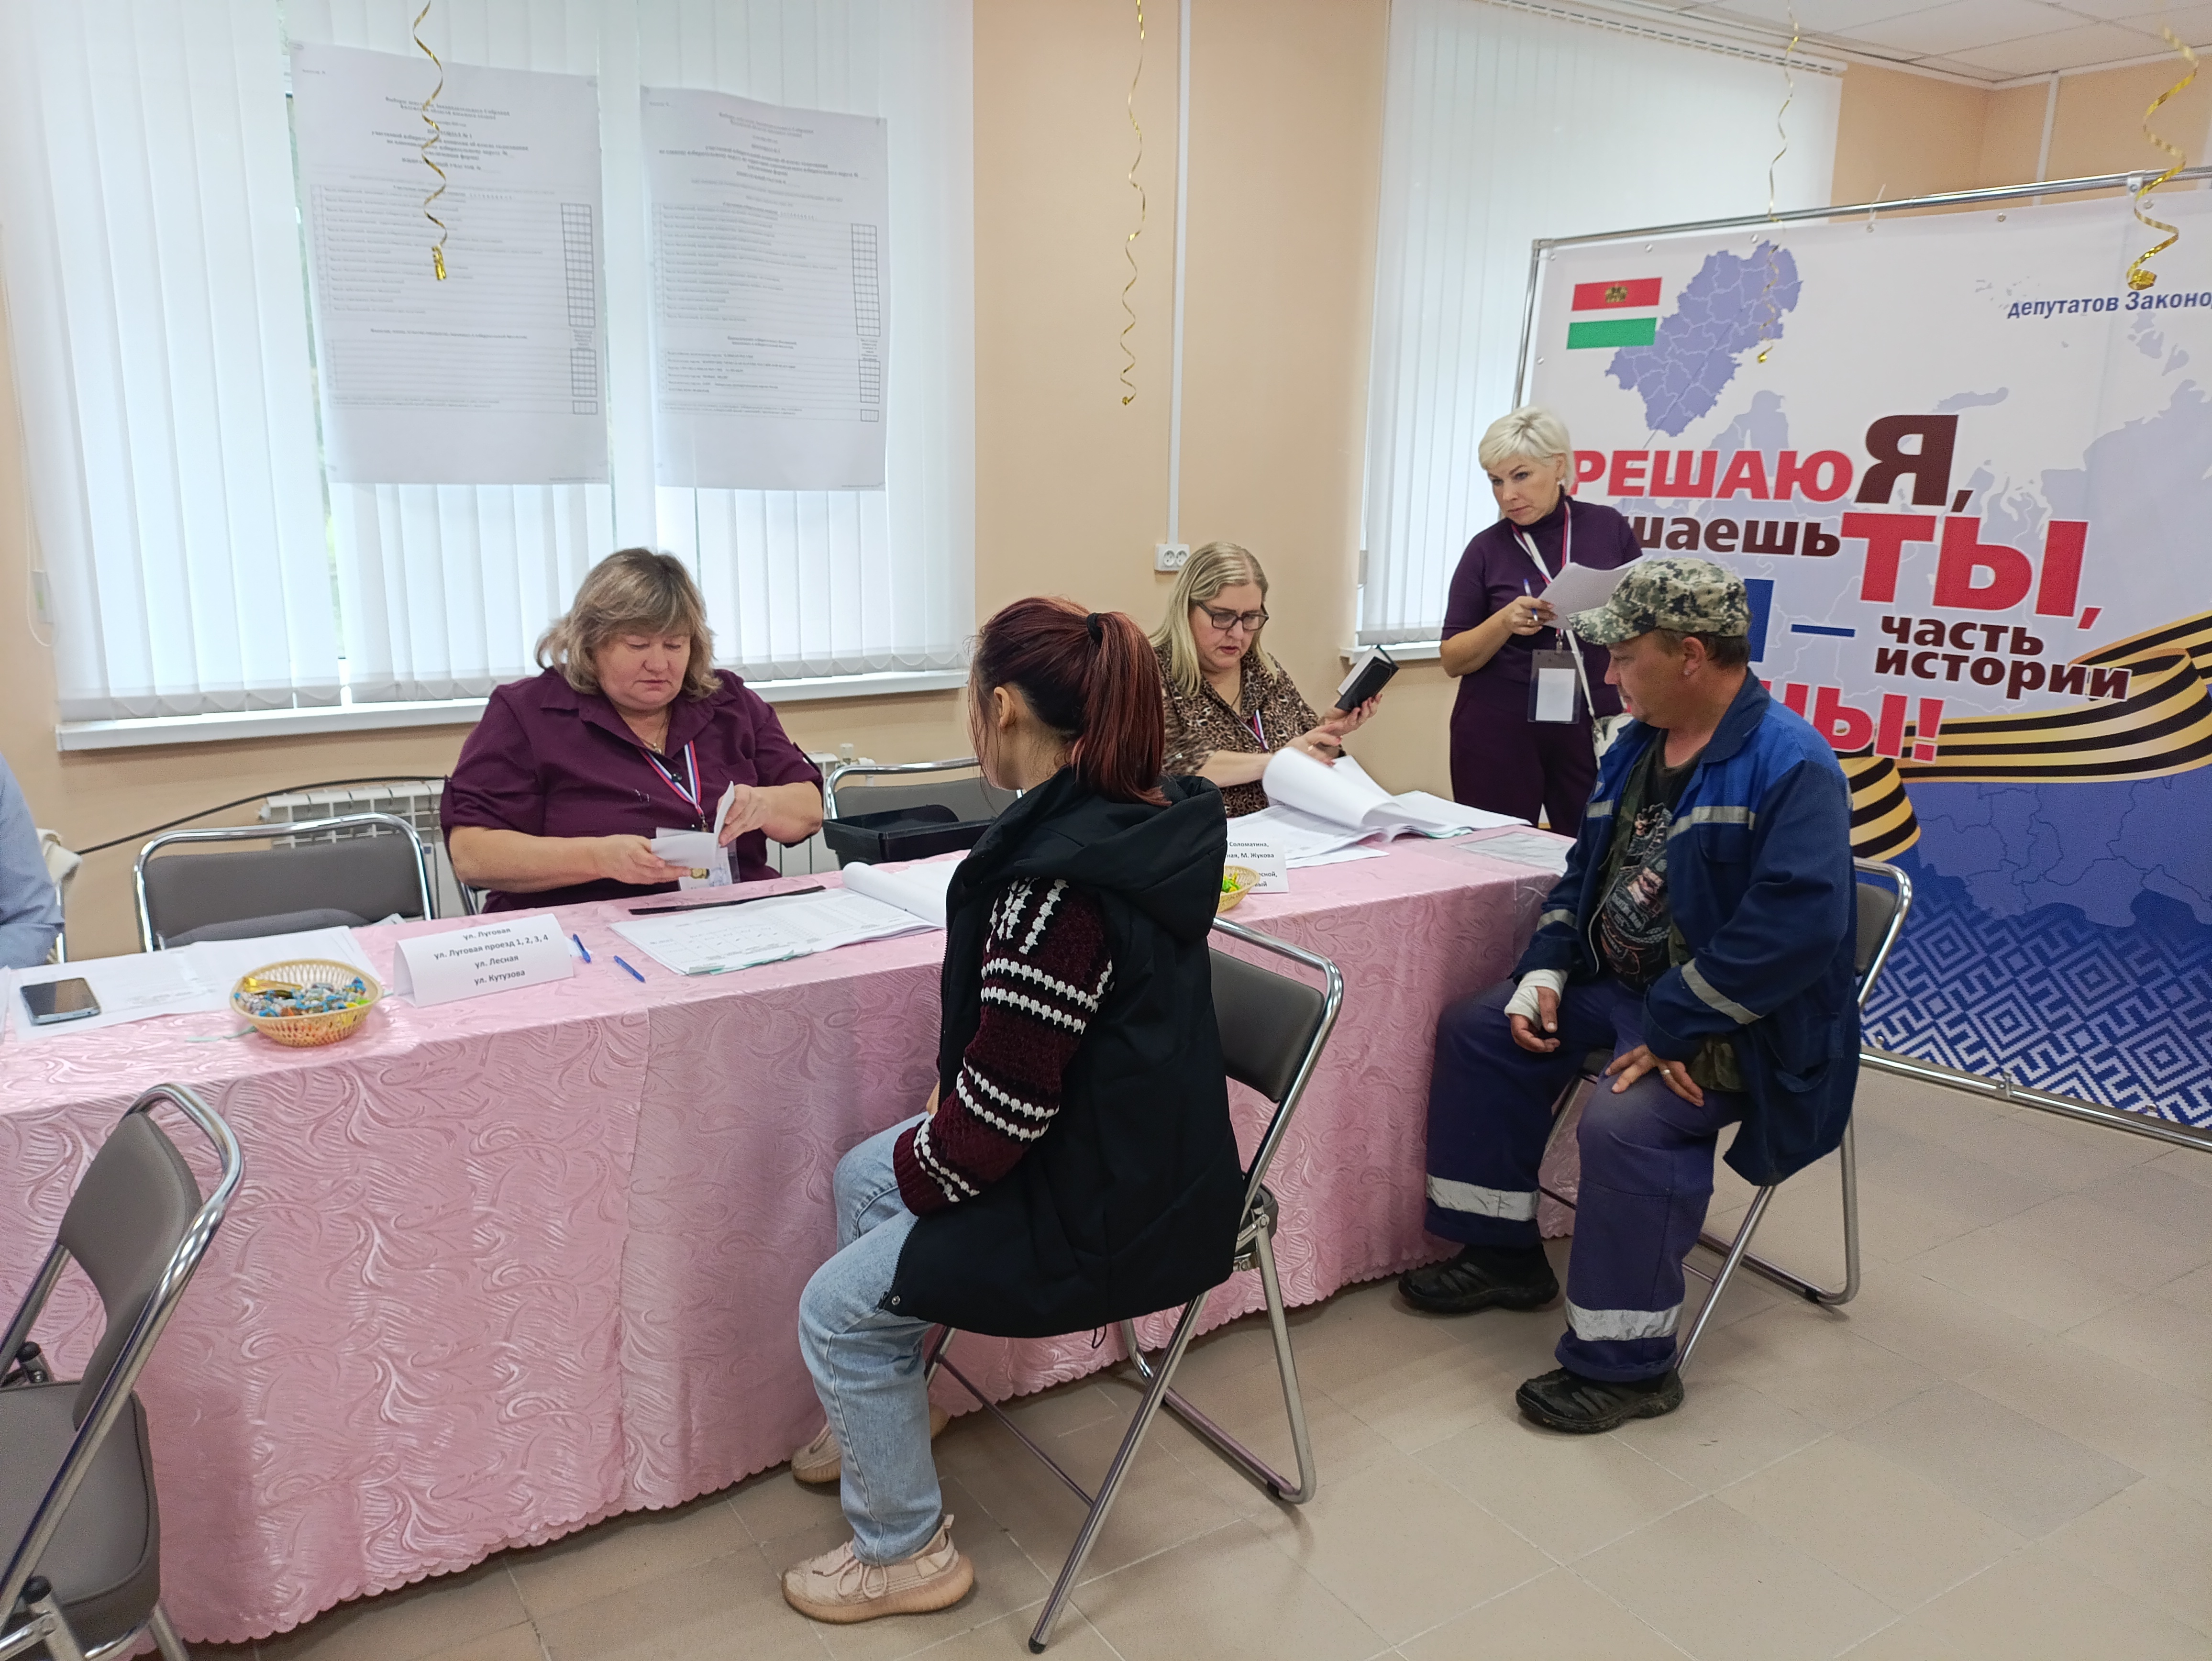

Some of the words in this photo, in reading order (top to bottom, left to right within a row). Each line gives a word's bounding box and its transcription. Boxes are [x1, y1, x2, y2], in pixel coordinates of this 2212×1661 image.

[2007, 297, 2119, 319] депутатов
[2125, 291, 2212, 311] Законо
[1570, 449, 1853, 503] РЕШАЮ
[1854, 414, 1974, 512] Я,
[1625, 516, 1841, 556] шаешь
[1840, 512, 2102, 630] ТЫ,
[1881, 615, 2045, 656] часть
[1874, 647, 2132, 700] истории
[478, 928, 511, 938] Луговая
[433, 952, 447, 960] ул.
[449, 945, 483, 956] Луговая
[485, 941, 515, 952] проезд
[489, 955, 519, 966] Лесная
[488, 969, 526, 983] Кутузова
